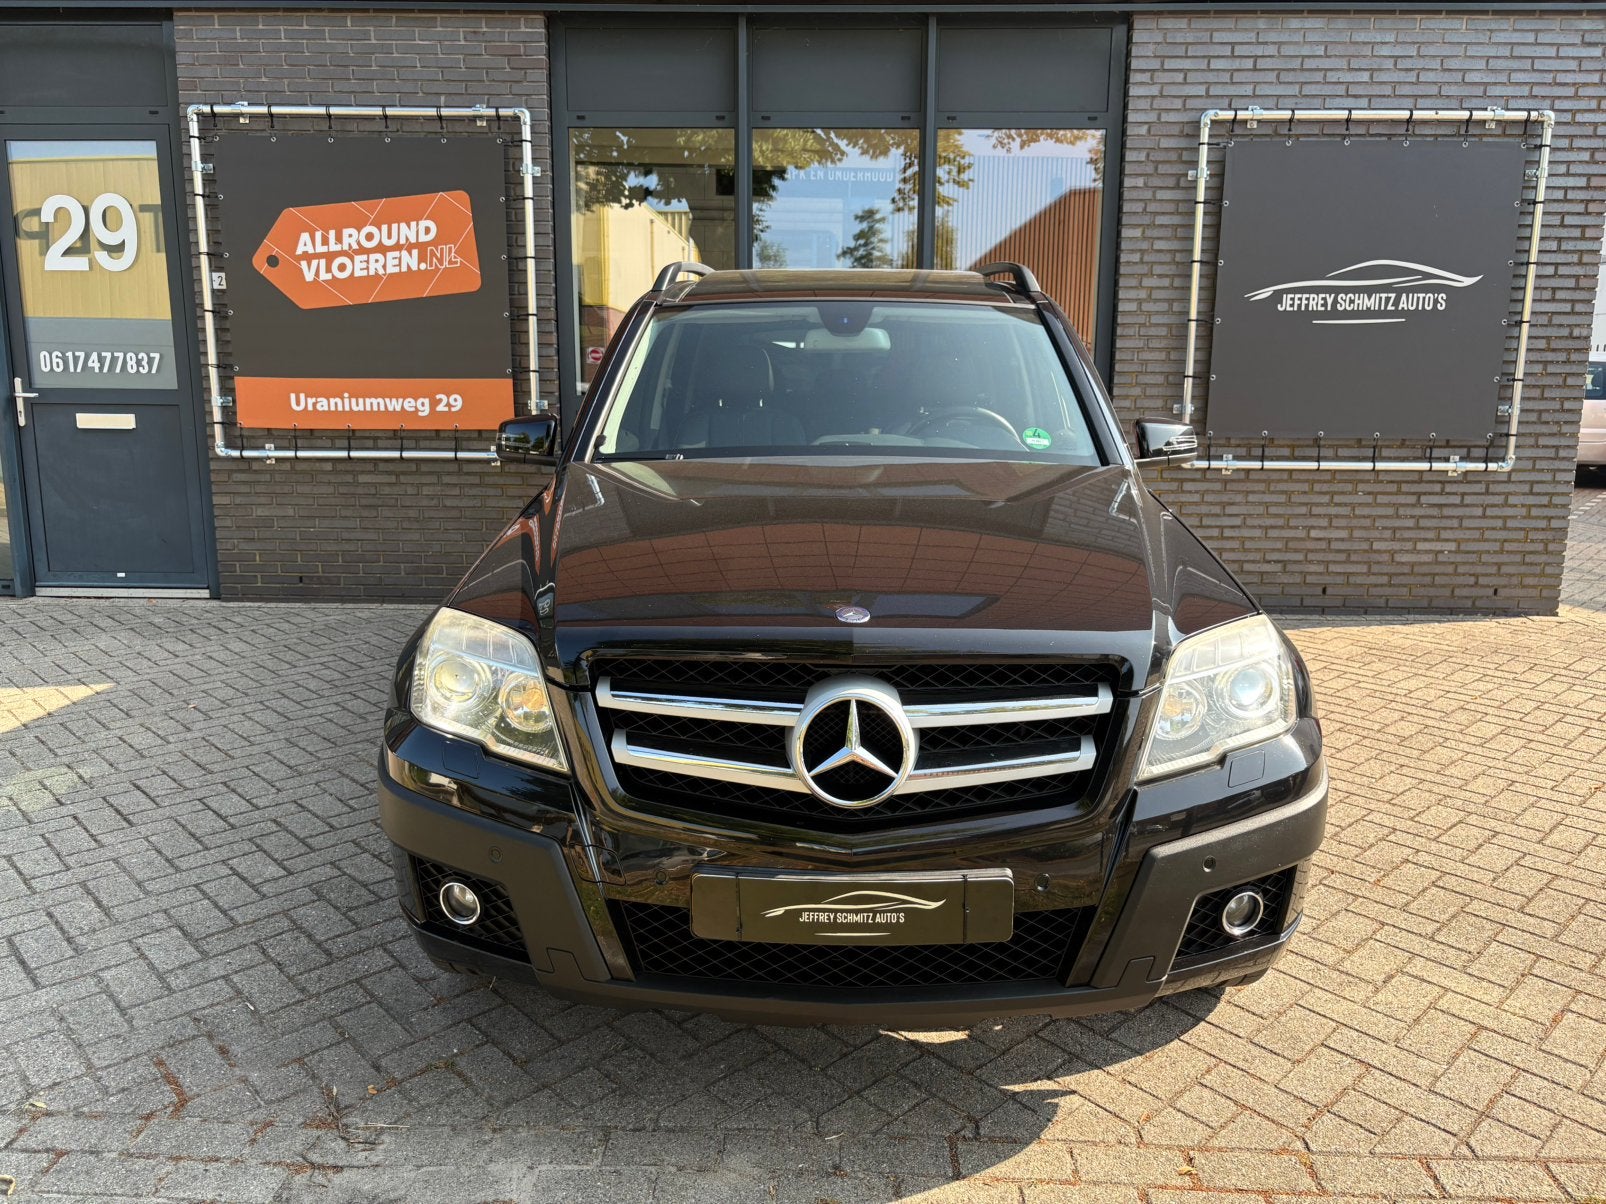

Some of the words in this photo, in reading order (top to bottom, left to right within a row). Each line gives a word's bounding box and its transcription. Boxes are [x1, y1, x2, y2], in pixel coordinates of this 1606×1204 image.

[40, 193, 138, 272] 29
[295, 219, 437, 255] ALLROUND
[299, 244, 461, 282] VLOEREN.NL
[217, 275, 224, 286] 2
[1277, 293, 1335, 311] JEFFREY
[1336, 293, 1396, 311] SCHMITZ
[1398, 293, 1447, 311] AUTO'S
[39, 351, 161, 374] 0617477837
[289, 392, 430, 416] Uraniumweg
[435, 393, 463, 412] 29
[799, 911, 835, 922] JEFFREY
[836, 912, 874, 923] SCHMITZ
[875, 912, 905, 923] AUTO'S
